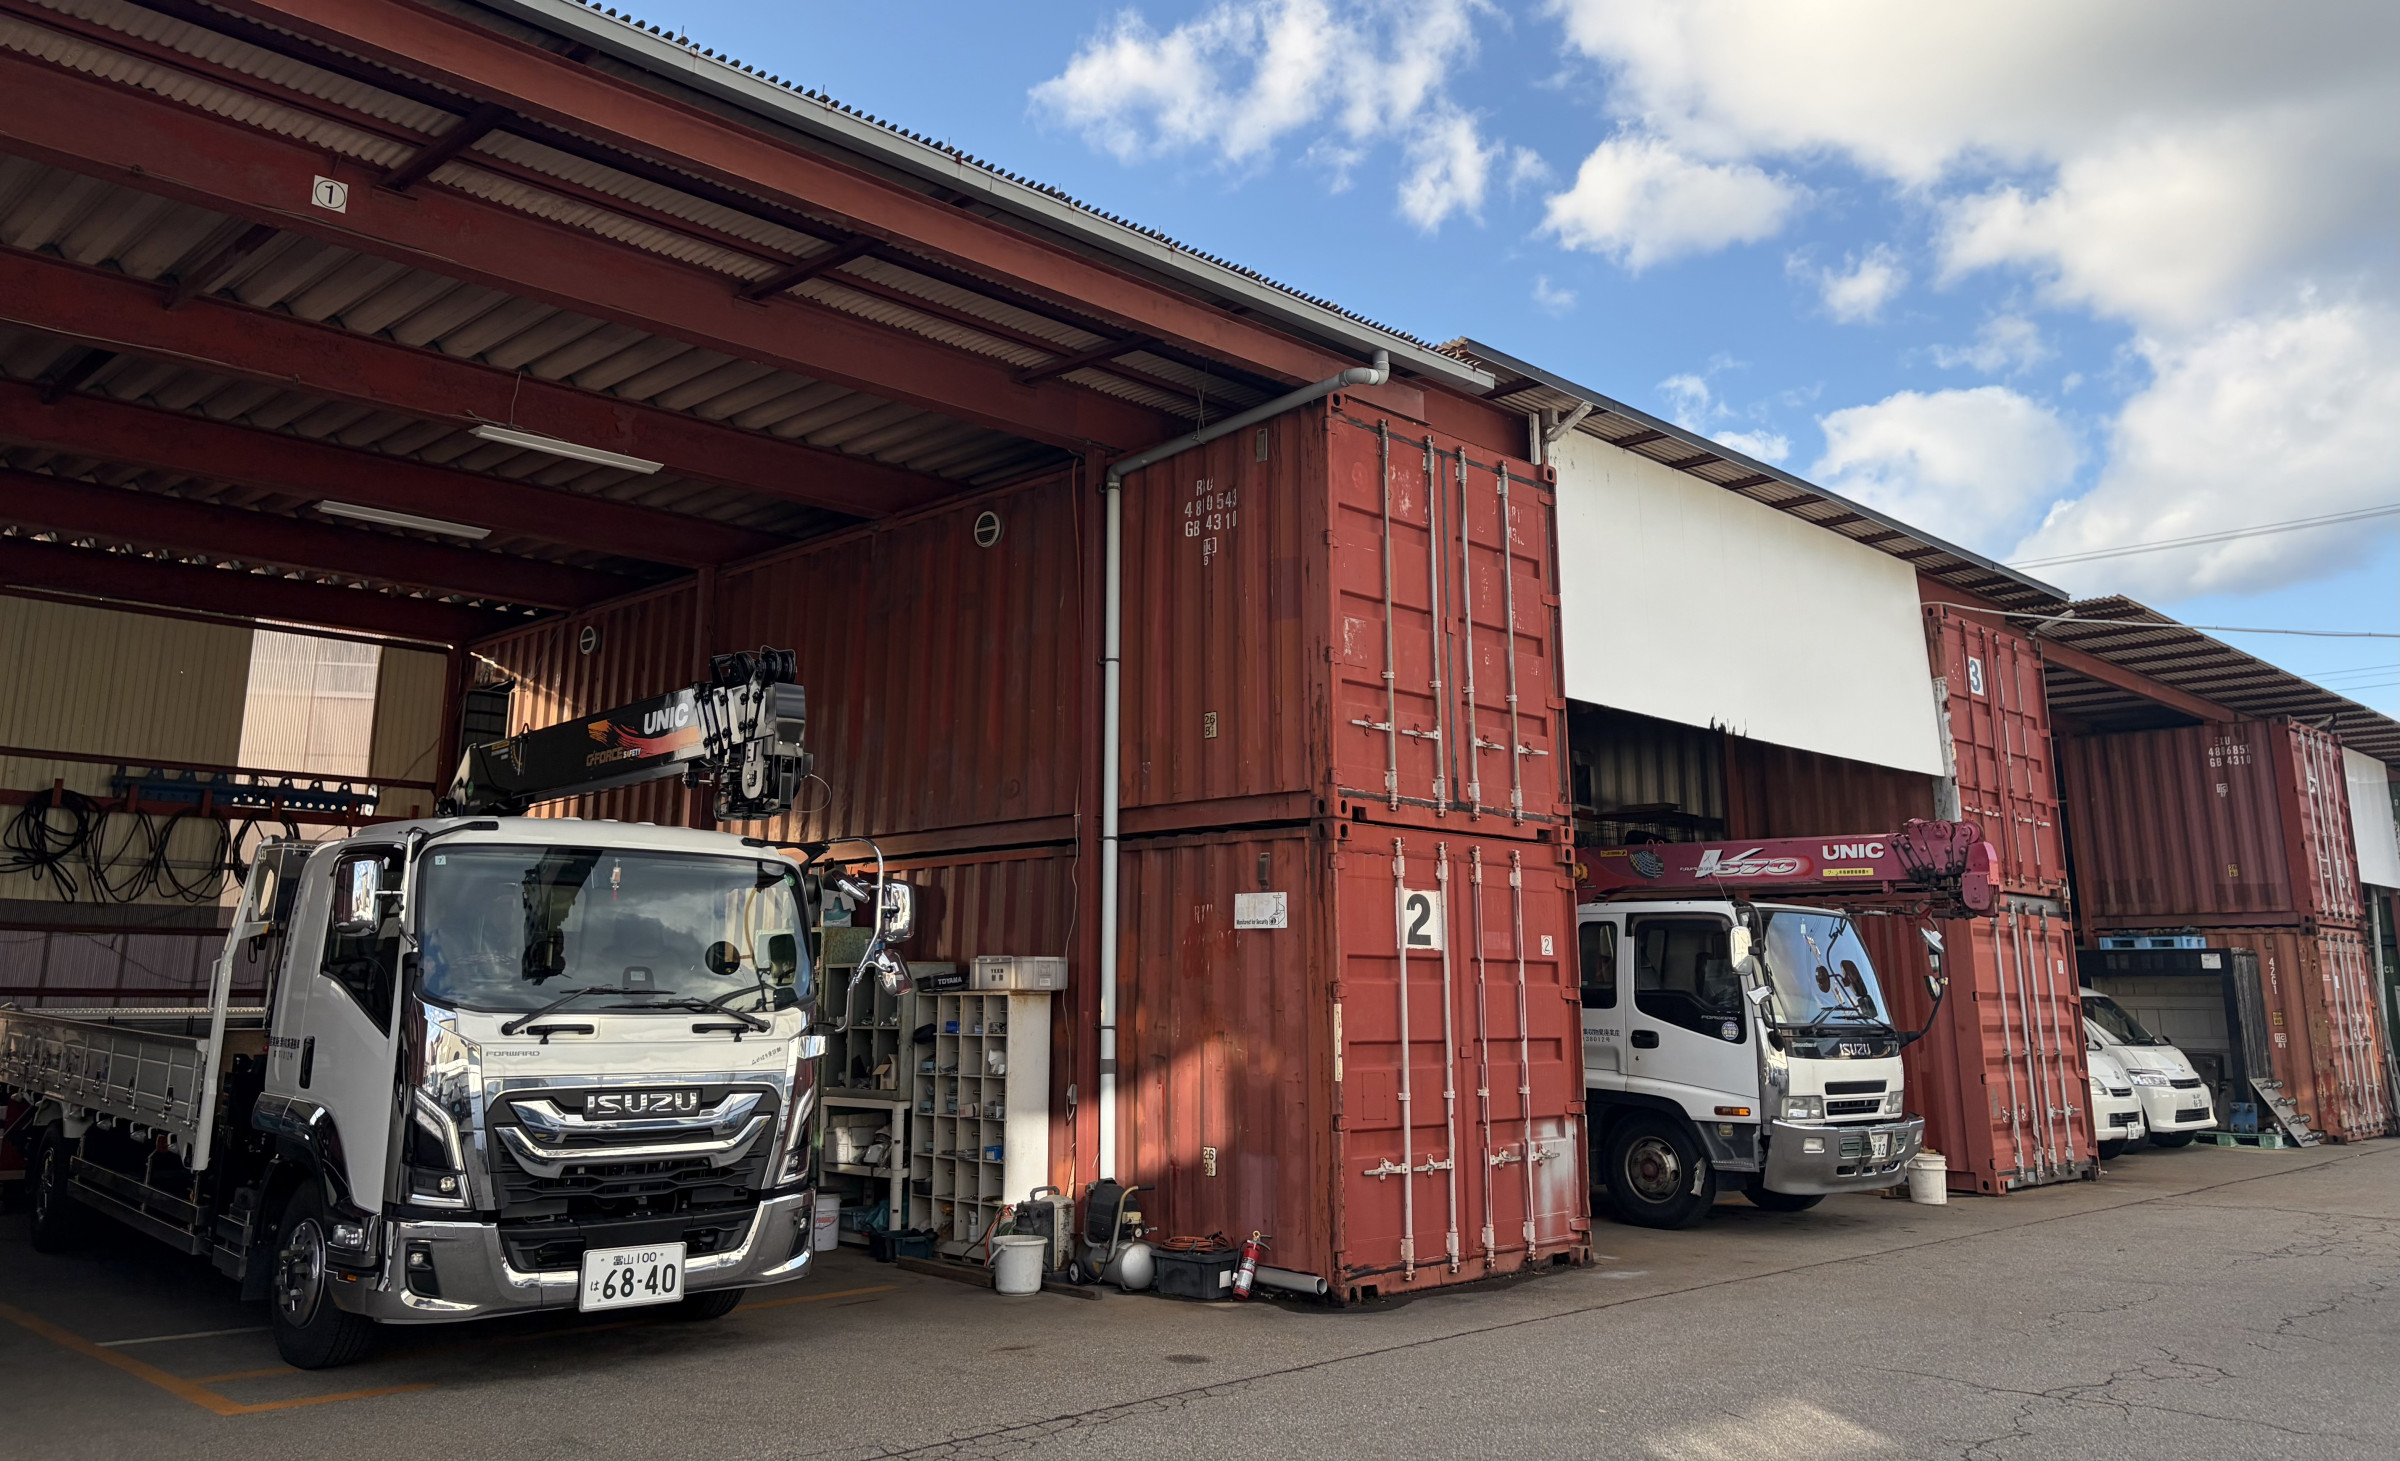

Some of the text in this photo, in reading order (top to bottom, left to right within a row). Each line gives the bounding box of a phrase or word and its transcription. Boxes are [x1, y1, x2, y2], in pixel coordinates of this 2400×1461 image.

[1185, 510, 1237, 537] GB 4310
[1969, 659, 1981, 692] 3
[643, 703, 689, 735] UNIC
[2209, 754, 2251, 768] GB 4310
[1822, 842, 1885, 861] UNIC
[1406, 893, 1432, 946] 2
[1839, 1043, 1871, 1056] ISUZU
[586, 1092, 698, 1115] ISUZU
[590, 1263, 676, 1300] は 68-40
